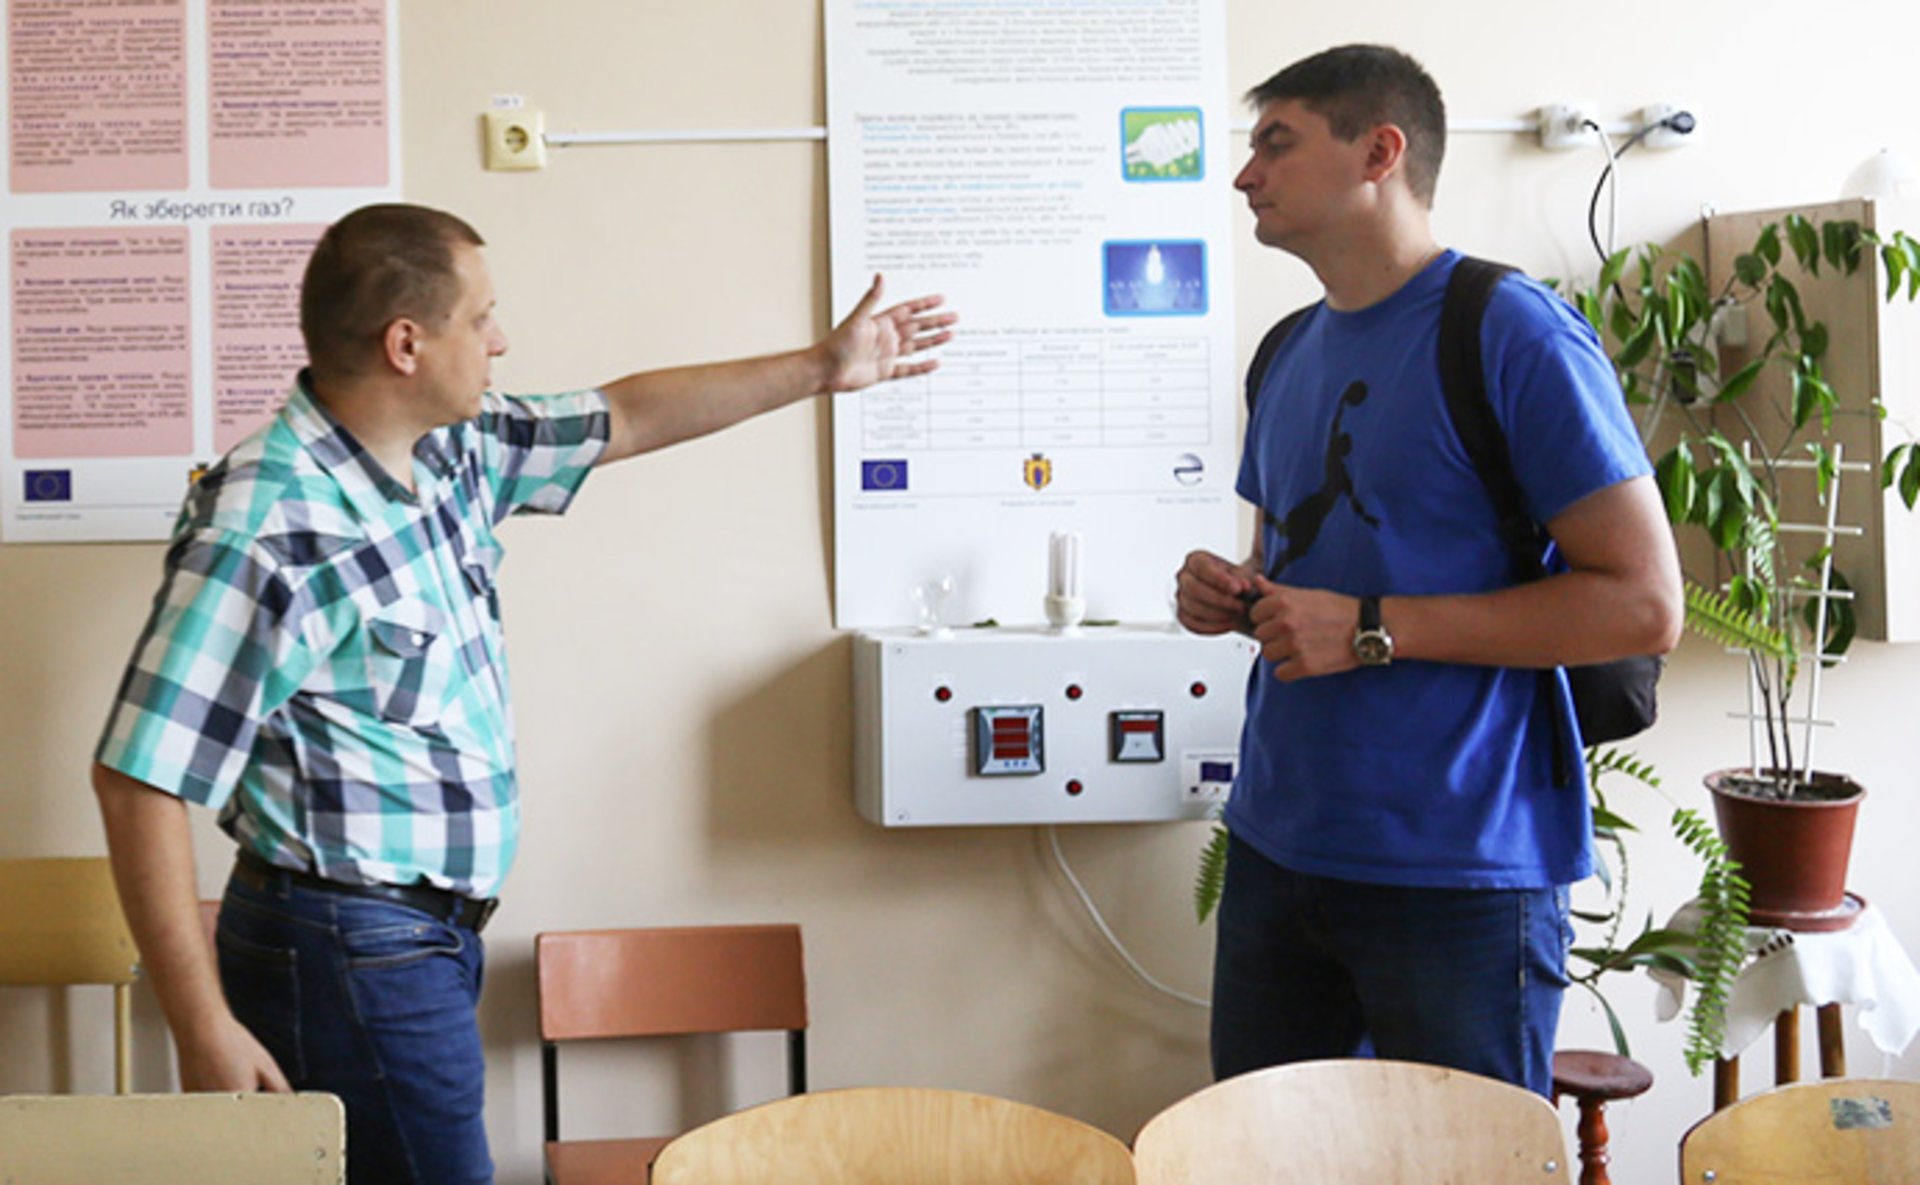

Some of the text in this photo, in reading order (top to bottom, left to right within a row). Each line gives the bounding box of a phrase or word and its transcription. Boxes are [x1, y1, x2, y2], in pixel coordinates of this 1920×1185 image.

[110, 197, 294, 221] Як зберегти газ?
